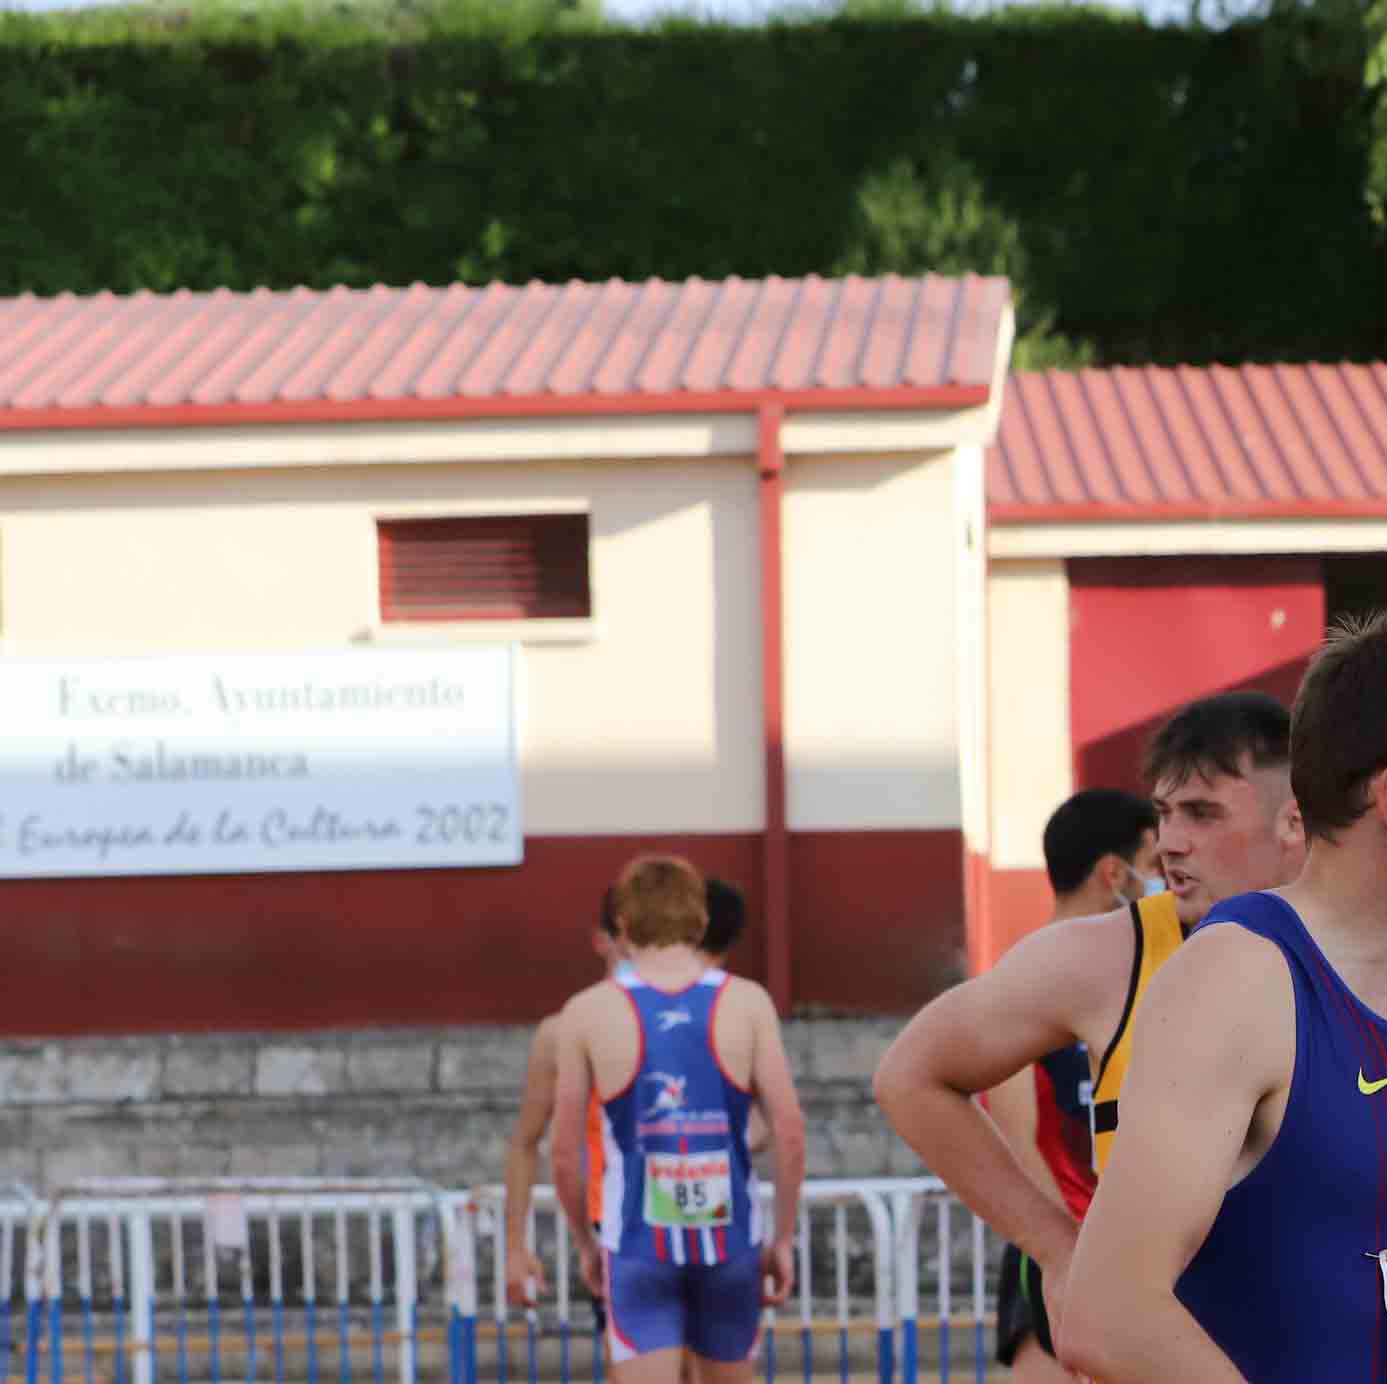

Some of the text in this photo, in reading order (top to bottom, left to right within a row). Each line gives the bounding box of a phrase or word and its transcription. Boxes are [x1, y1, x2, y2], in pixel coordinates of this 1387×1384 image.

[210, 672, 465, 722] Ayuntamiento
[53, 738, 309, 785] de Salamanca
[17, 812, 153, 863] Europea
[162, 806, 202, 847] de
[211, 807, 249, 846] la
[258, 801, 403, 848] Cultura
[413, 800, 509, 845] 2002
[674, 1182, 707, 1208] 85
